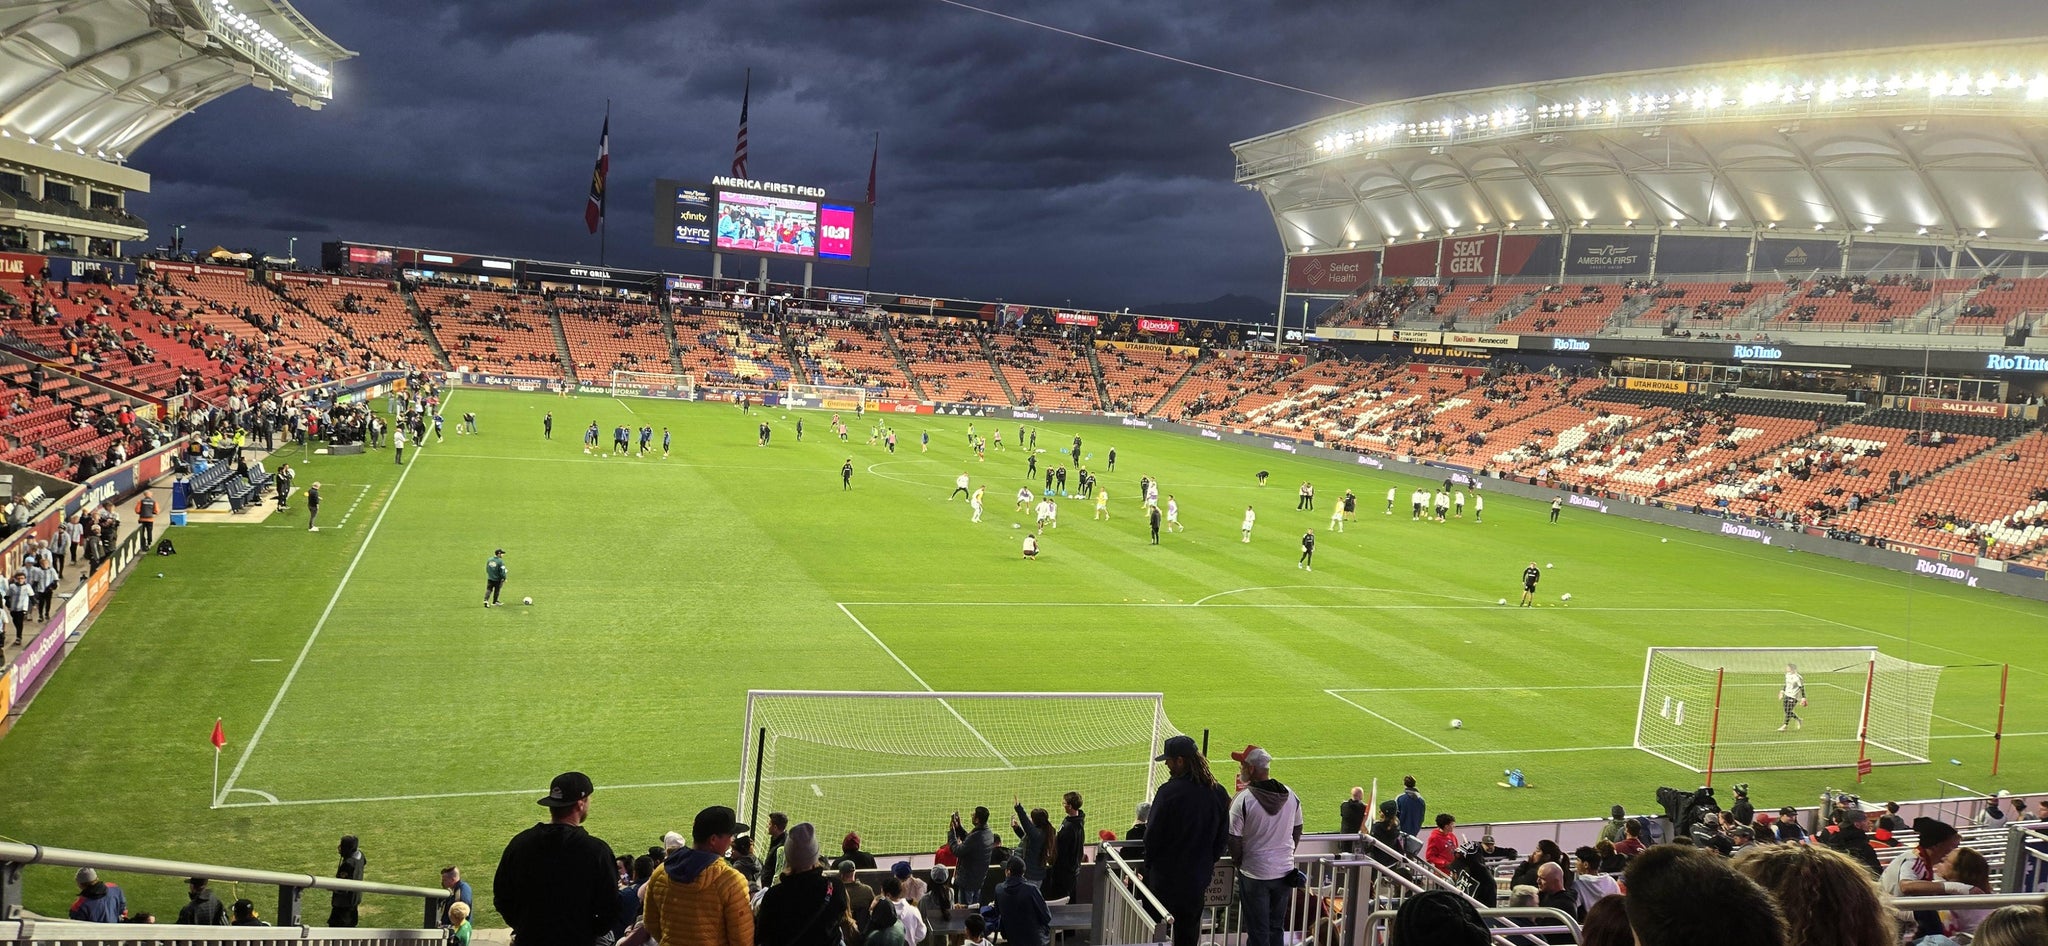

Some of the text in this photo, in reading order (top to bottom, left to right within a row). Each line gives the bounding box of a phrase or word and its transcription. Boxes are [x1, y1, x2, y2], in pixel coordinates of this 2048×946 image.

[712, 176, 826, 198] AMERICA FIRST FIELD
[680, 210, 706, 222] xfinity
[822, 225, 850, 240] 10:31
[1453, 240, 1484, 257] SEAT
[1450, 257, 1483, 273] GEEK
[1577, 256, 1638, 265] AMERICA FIRST
[5, 260, 24, 274] LAKE
[1330, 262, 1359, 272] Select
[1328, 273, 1357, 283] Health
[675, 282, 700, 290] BELIEVE
[919, 299, 938, 307] Caesrs
[1059, 313, 1095, 321] PEPPERMILL
[816, 318, 850, 327] BEIEVE
[1150, 322, 1175, 332] beddy's
[1651, 381, 1678, 390] ROYALS
[895, 404, 917, 412] Coca-Cola
[1942, 402, 1966, 412] SALT
[1968, 404, 1998, 414] LAKE
